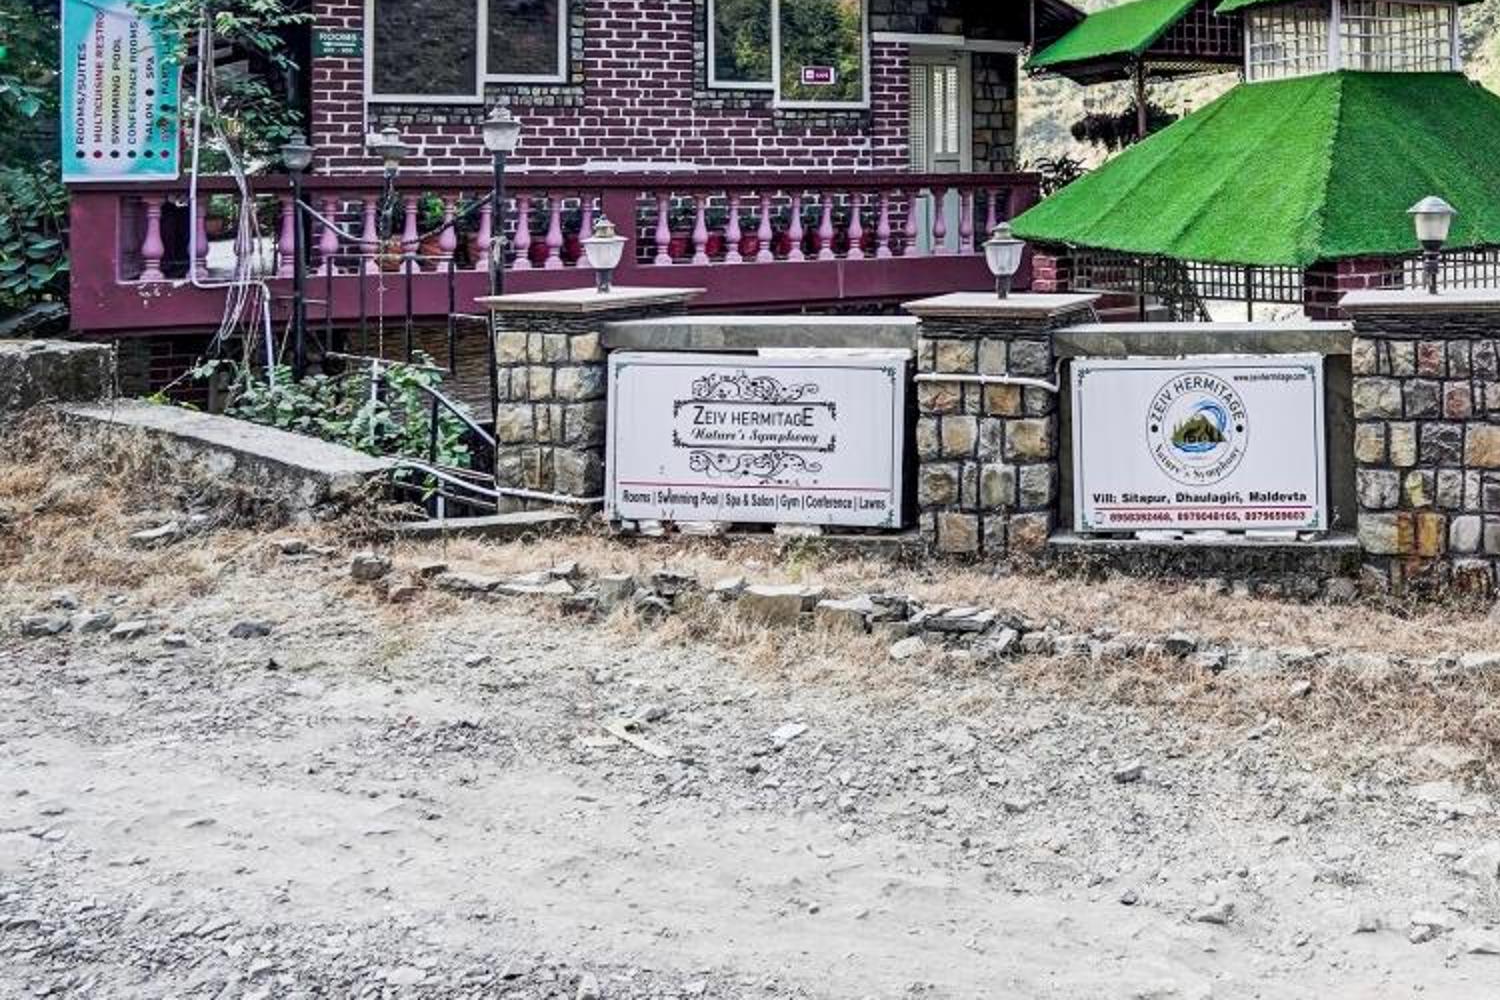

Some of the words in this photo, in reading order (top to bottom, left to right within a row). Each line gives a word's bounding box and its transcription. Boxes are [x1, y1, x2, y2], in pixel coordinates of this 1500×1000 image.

[113, 37, 122, 71] POOL
[130, 21, 139, 63] ROOMS
[146, 55, 155, 79] SPA
[75, 42, 87, 145] ROOMS/SUITES
[93, 61, 104, 143] MULTICUISINE
[110, 75, 121, 145] SWIMMING
[127, 67, 138, 145] CONFERENCE
[693, 405, 727, 425] ZEIV
[731, 407, 815, 426] HERMITAGE
[1151, 389, 1172, 422] ZEIV
[1174, 376, 1244, 421] HERMITAGE
[691, 427, 745, 441] Nature's
[749, 429, 818, 445] Symphony
[623, 489, 651, 503] Rooms
[657, 490, 699, 508] Swimming
[700, 491, 718, 505] Pool
[725, 493, 741, 508] Spa
[751, 494, 774, 507] Salon
[780, 494, 800, 511] Gym
[805, 495, 852, 509] Conference
[859, 497, 886, 510] Lawns
[1121, 492, 1171, 505] Sitapur,
[1175, 492, 1243, 505] Dhaulagiri,
[1249, 492, 1307, 502] Maldevta
